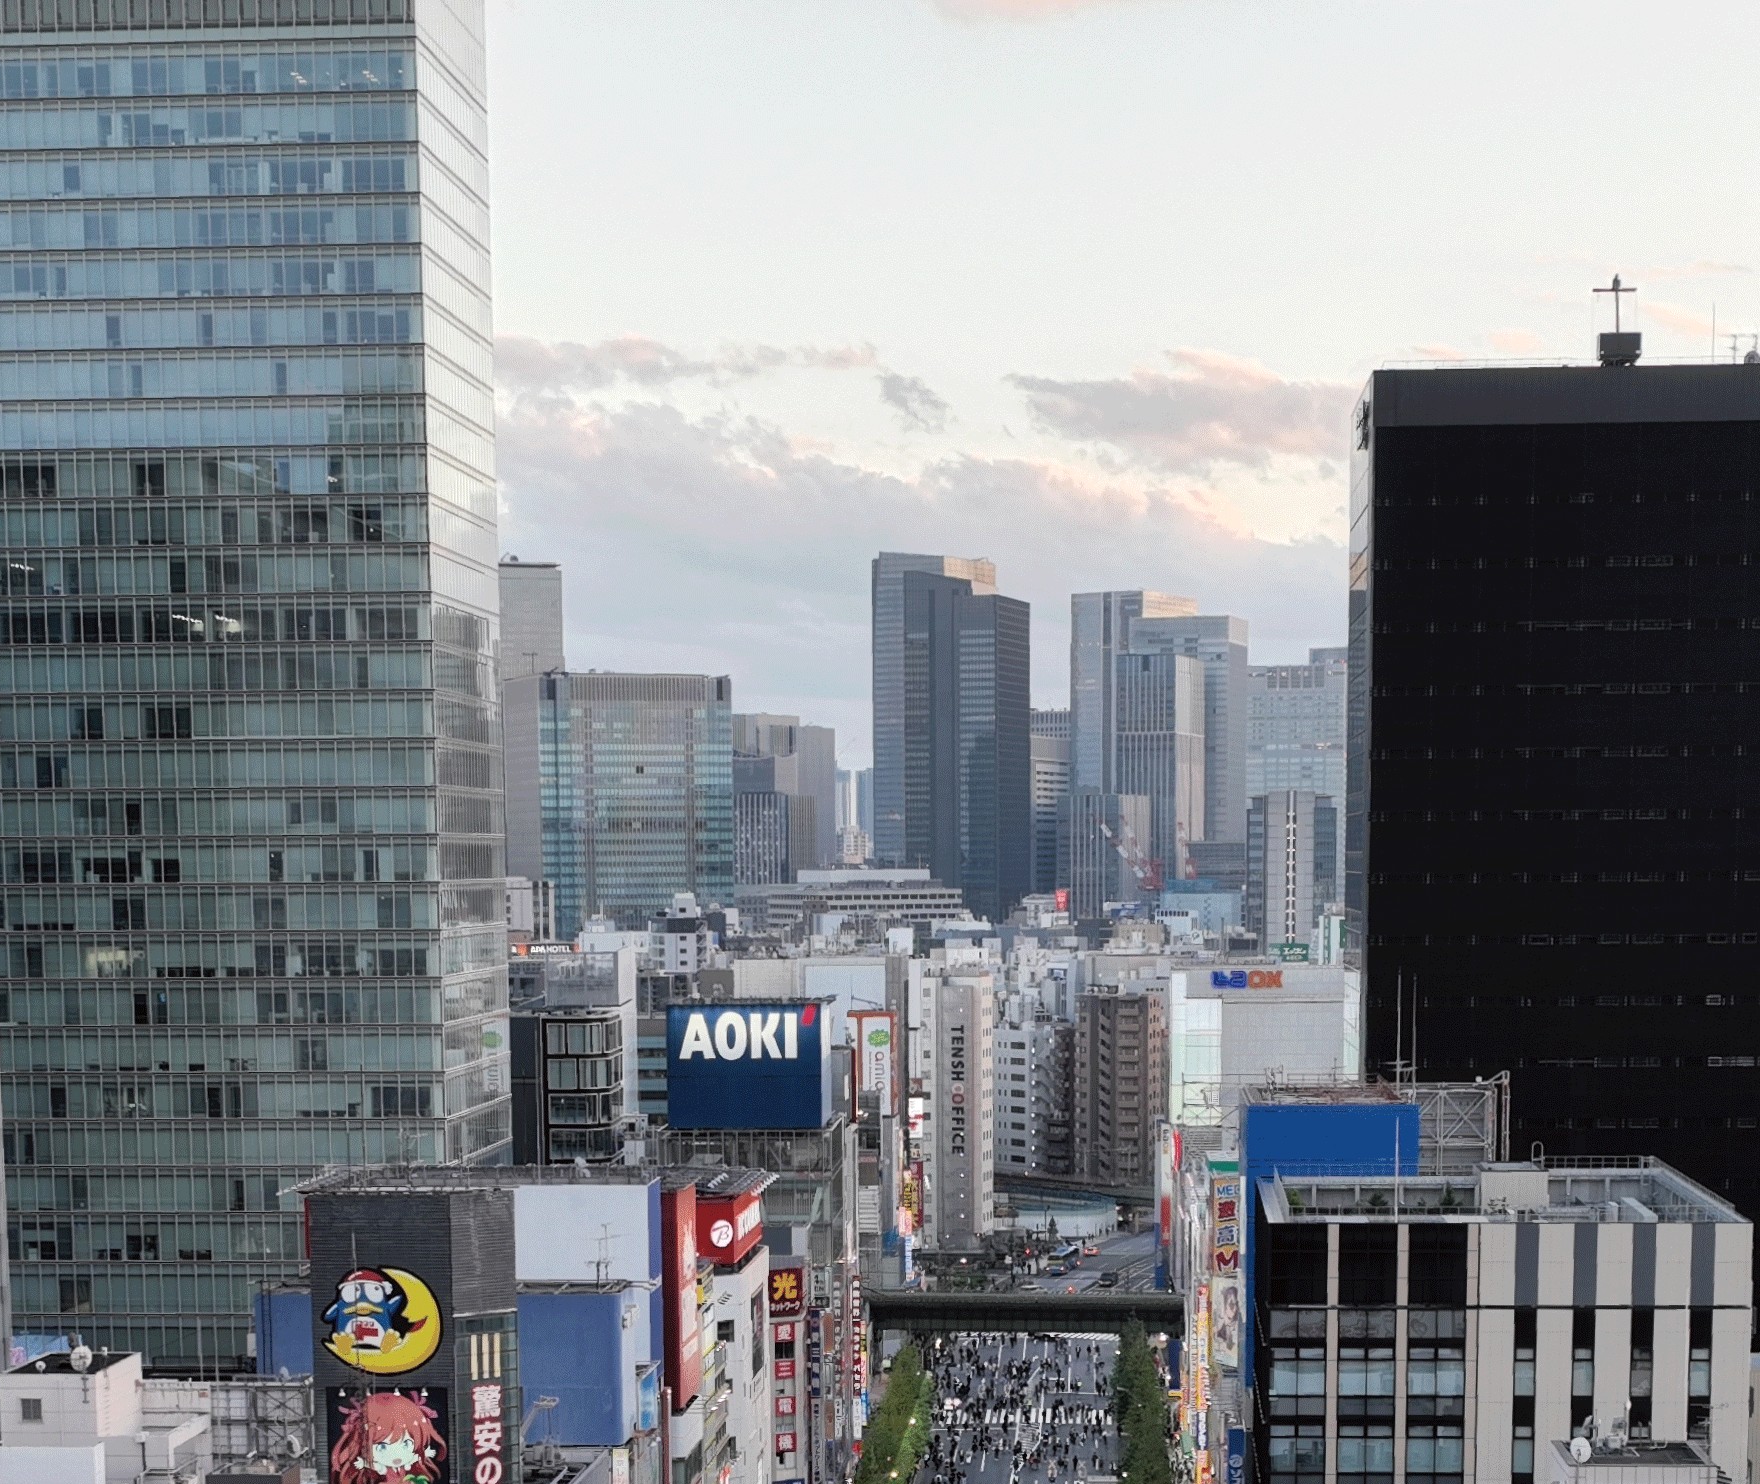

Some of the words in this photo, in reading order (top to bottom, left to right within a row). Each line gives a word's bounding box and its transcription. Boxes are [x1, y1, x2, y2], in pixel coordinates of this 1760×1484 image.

[680, 1012, 799, 1060] AOKI
[951, 1096, 964, 1154] OFFICE
[772, 1272, 797, 1300] 光
[770, 1301, 801, 1312] ネットワーク
